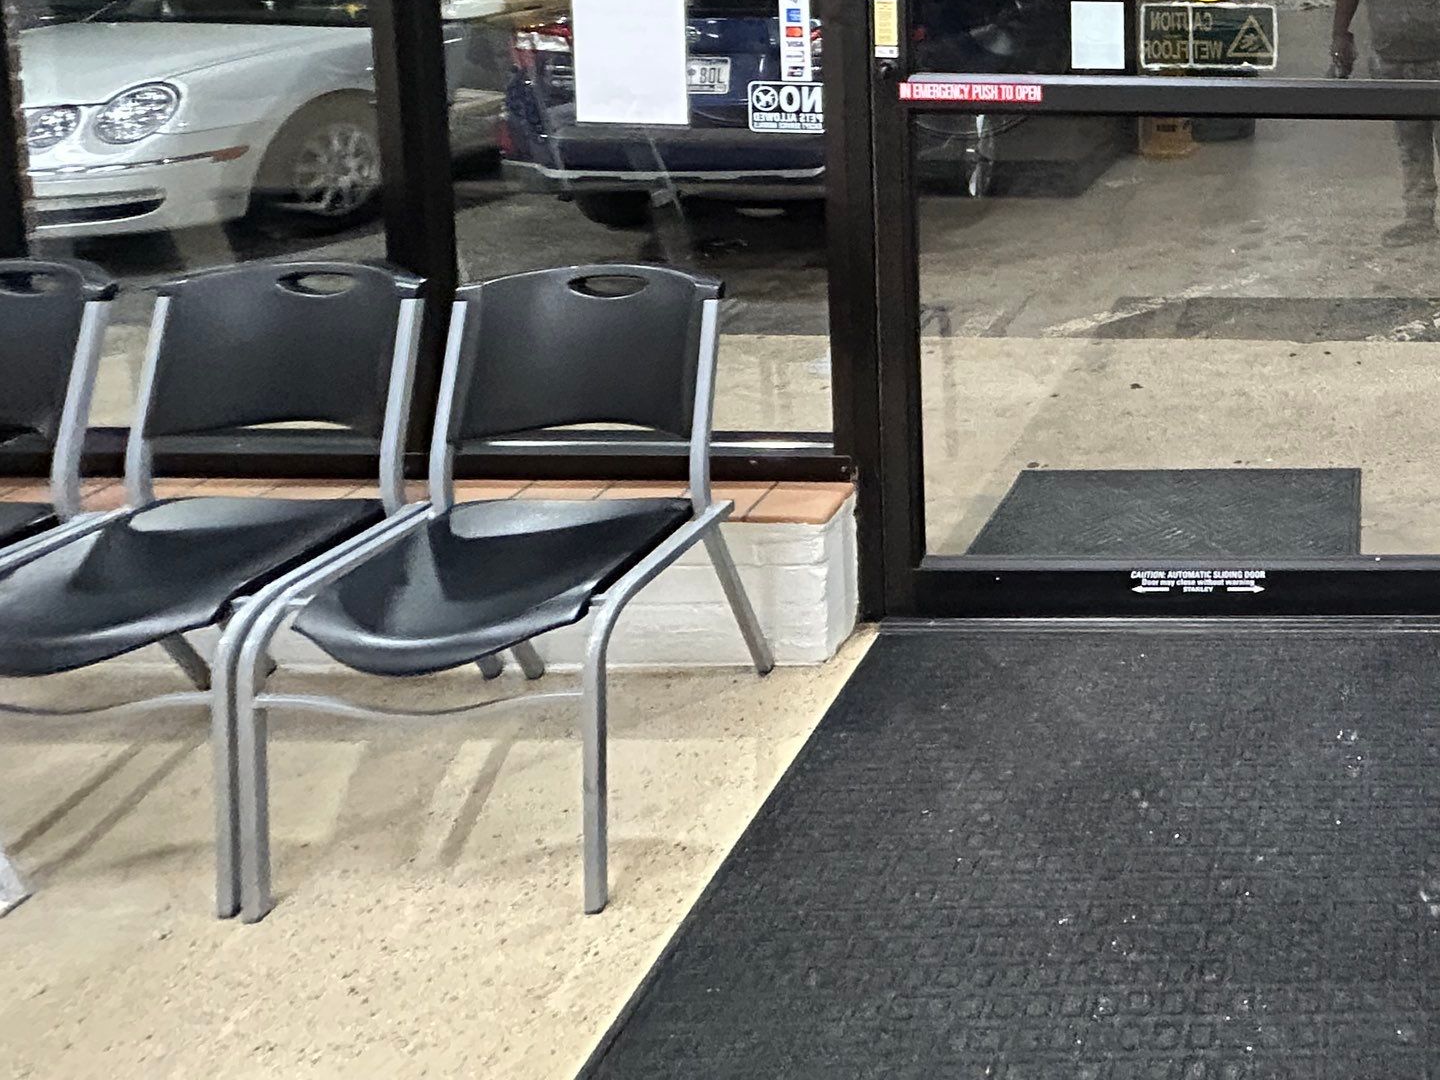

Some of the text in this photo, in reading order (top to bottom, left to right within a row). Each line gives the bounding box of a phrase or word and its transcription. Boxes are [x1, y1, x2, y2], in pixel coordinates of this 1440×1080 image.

[900, 83, 1041, 101] IN EMERGENCY PUSH TO OPEN
[1167, 571, 1212, 579] AUTOMATIC
[1213, 571, 1242, 579] SLIDING
[1244, 571, 1266, 579] DOOR
